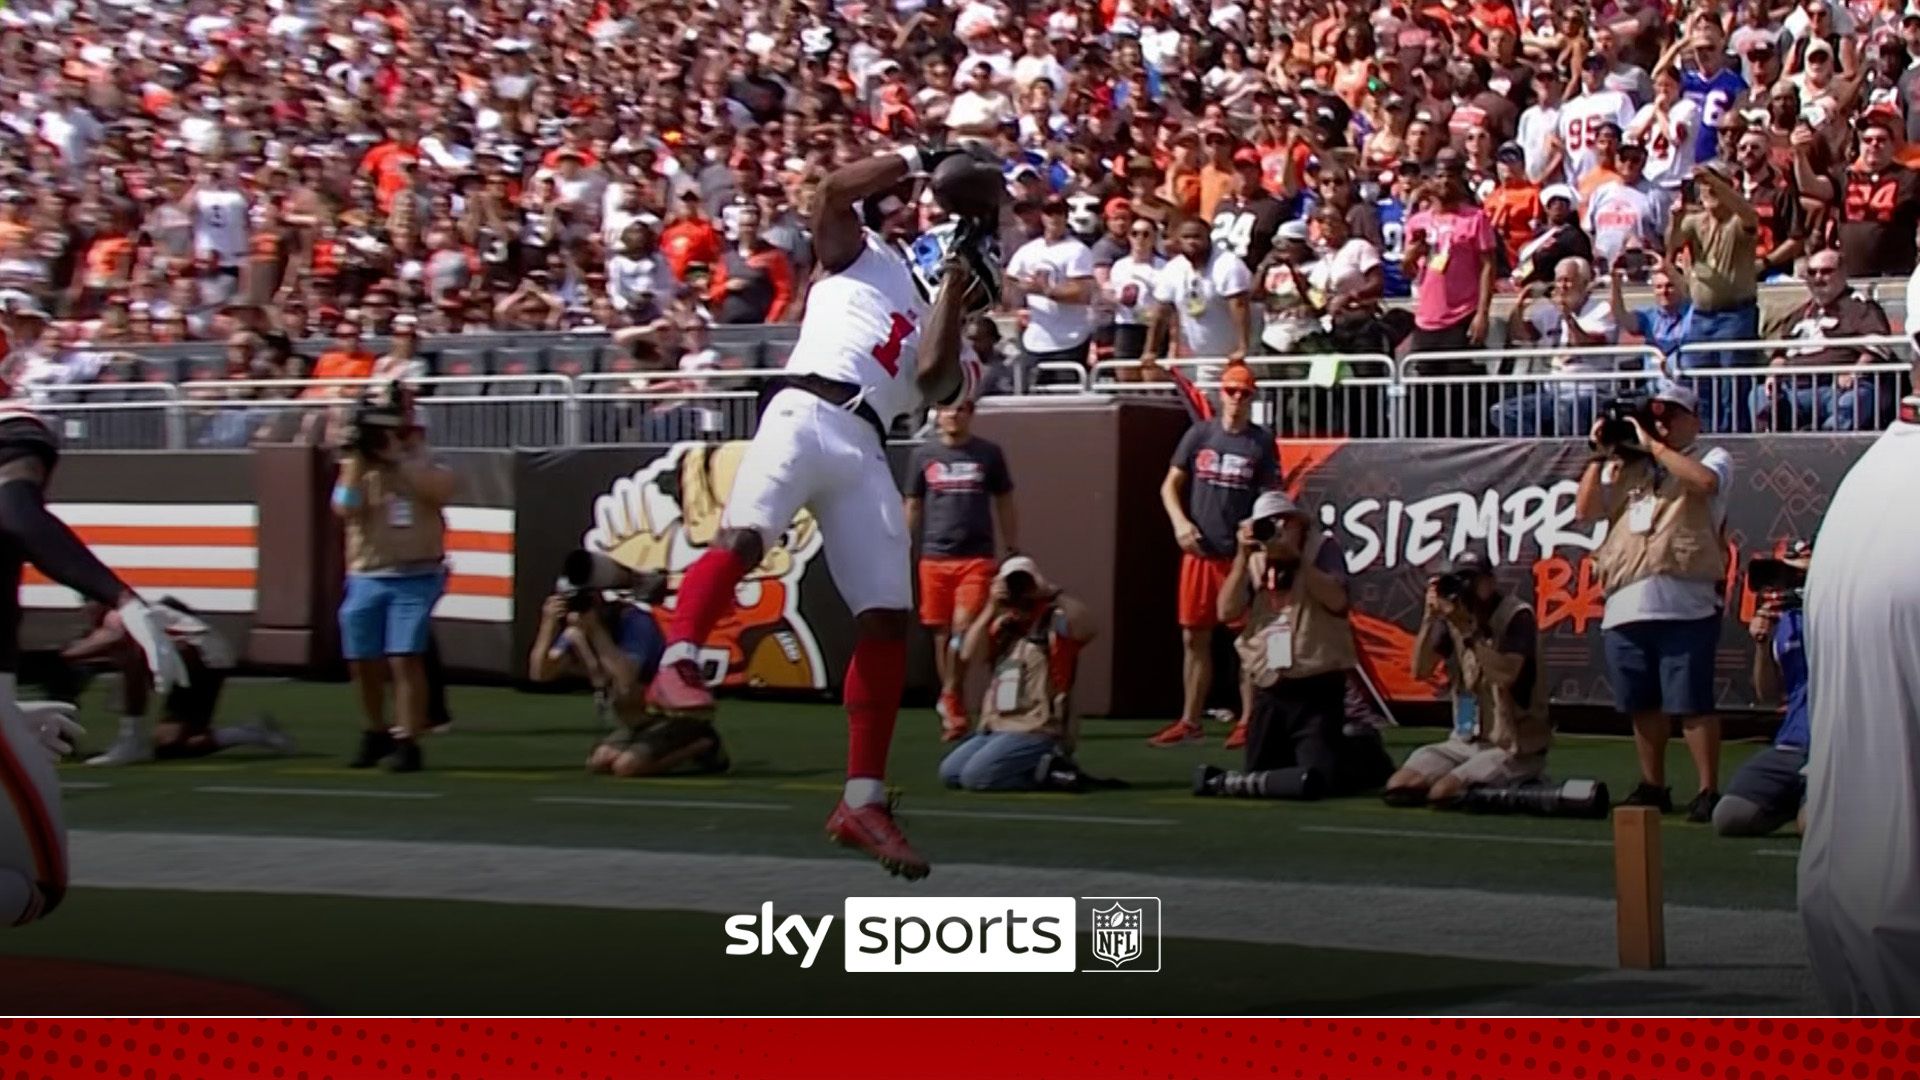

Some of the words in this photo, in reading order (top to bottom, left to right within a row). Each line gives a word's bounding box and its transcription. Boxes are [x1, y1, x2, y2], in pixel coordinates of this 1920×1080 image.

[1569, 115, 1601, 150] 95
[1845, 182, 1897, 220] 24
[1211, 211, 1256, 257] 24
[872, 311, 915, 379] 1
[1320, 479, 1609, 574] SIEMPR
